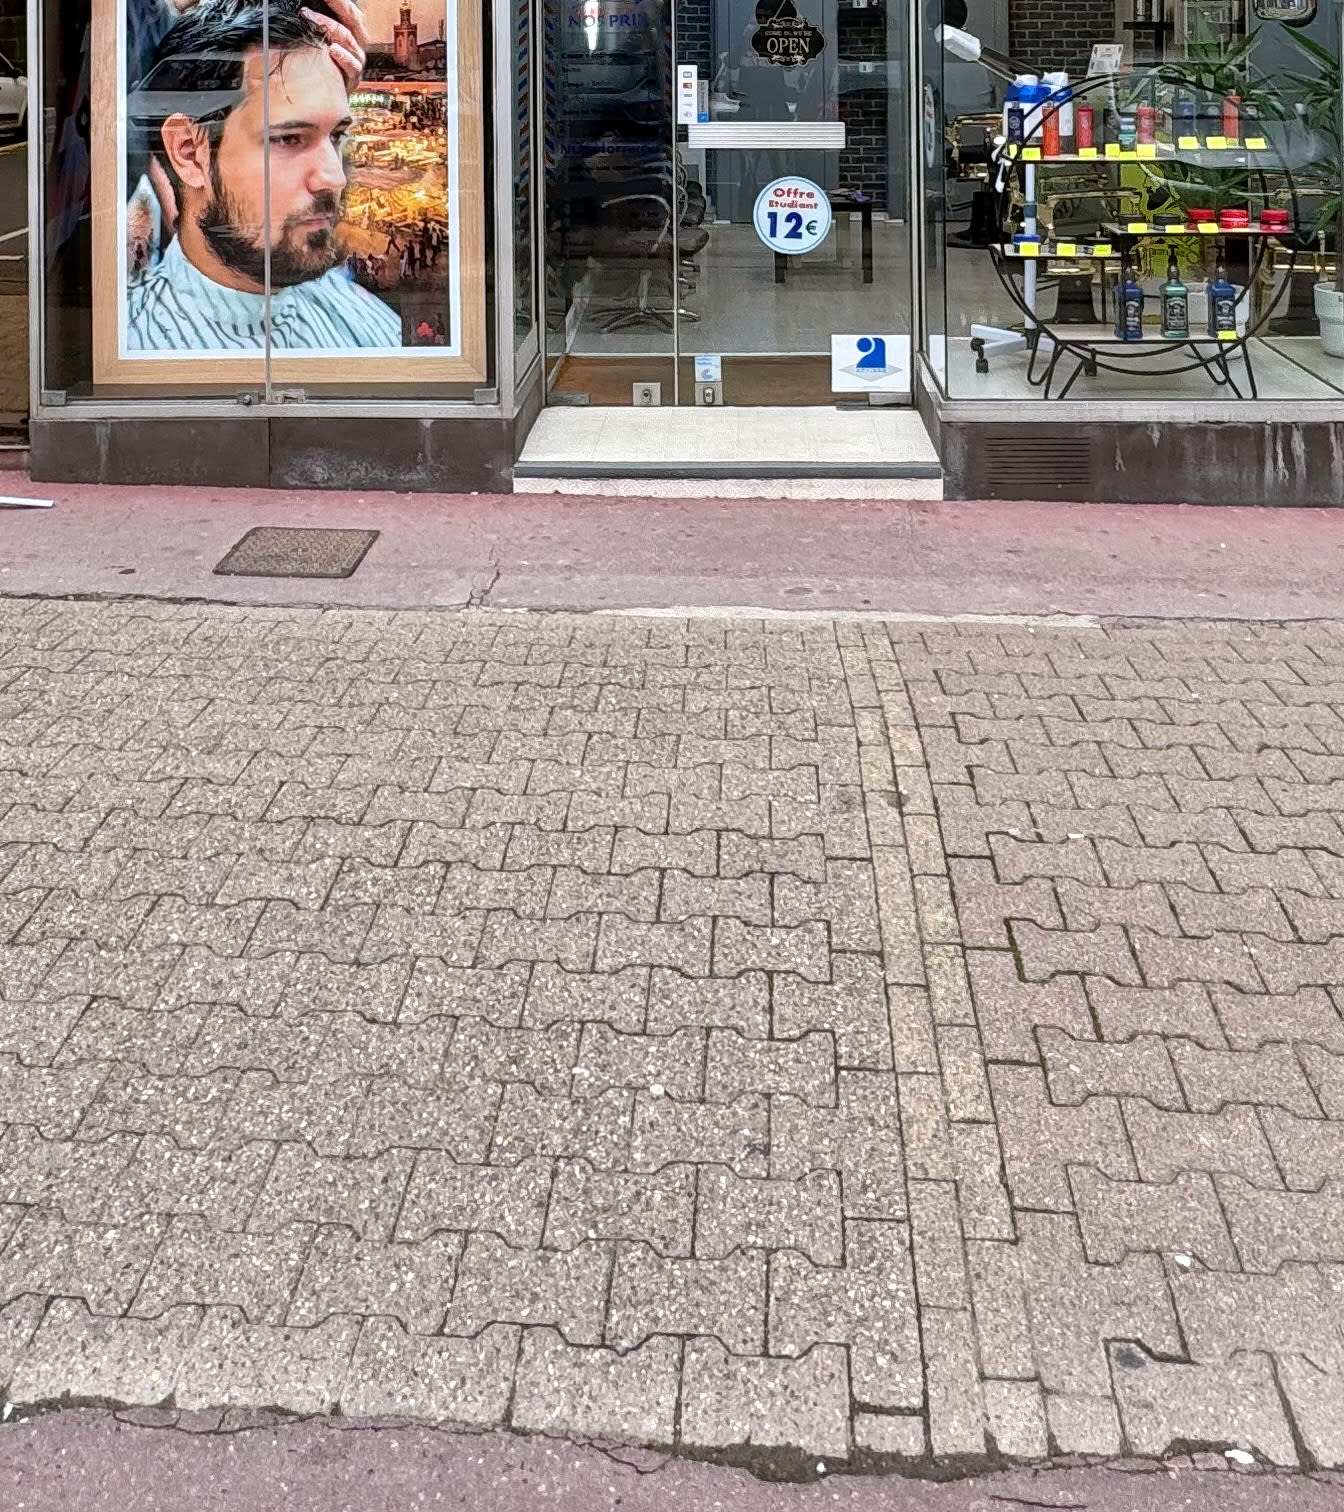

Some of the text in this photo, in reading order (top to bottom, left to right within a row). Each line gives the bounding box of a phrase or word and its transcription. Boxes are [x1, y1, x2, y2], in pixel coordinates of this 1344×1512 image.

[766, 37, 811, 54] OPEN
[772, 187, 815, 199] Offre
[768, 199, 819, 209] Etudiant
[767, 211, 818, 240] 12€
